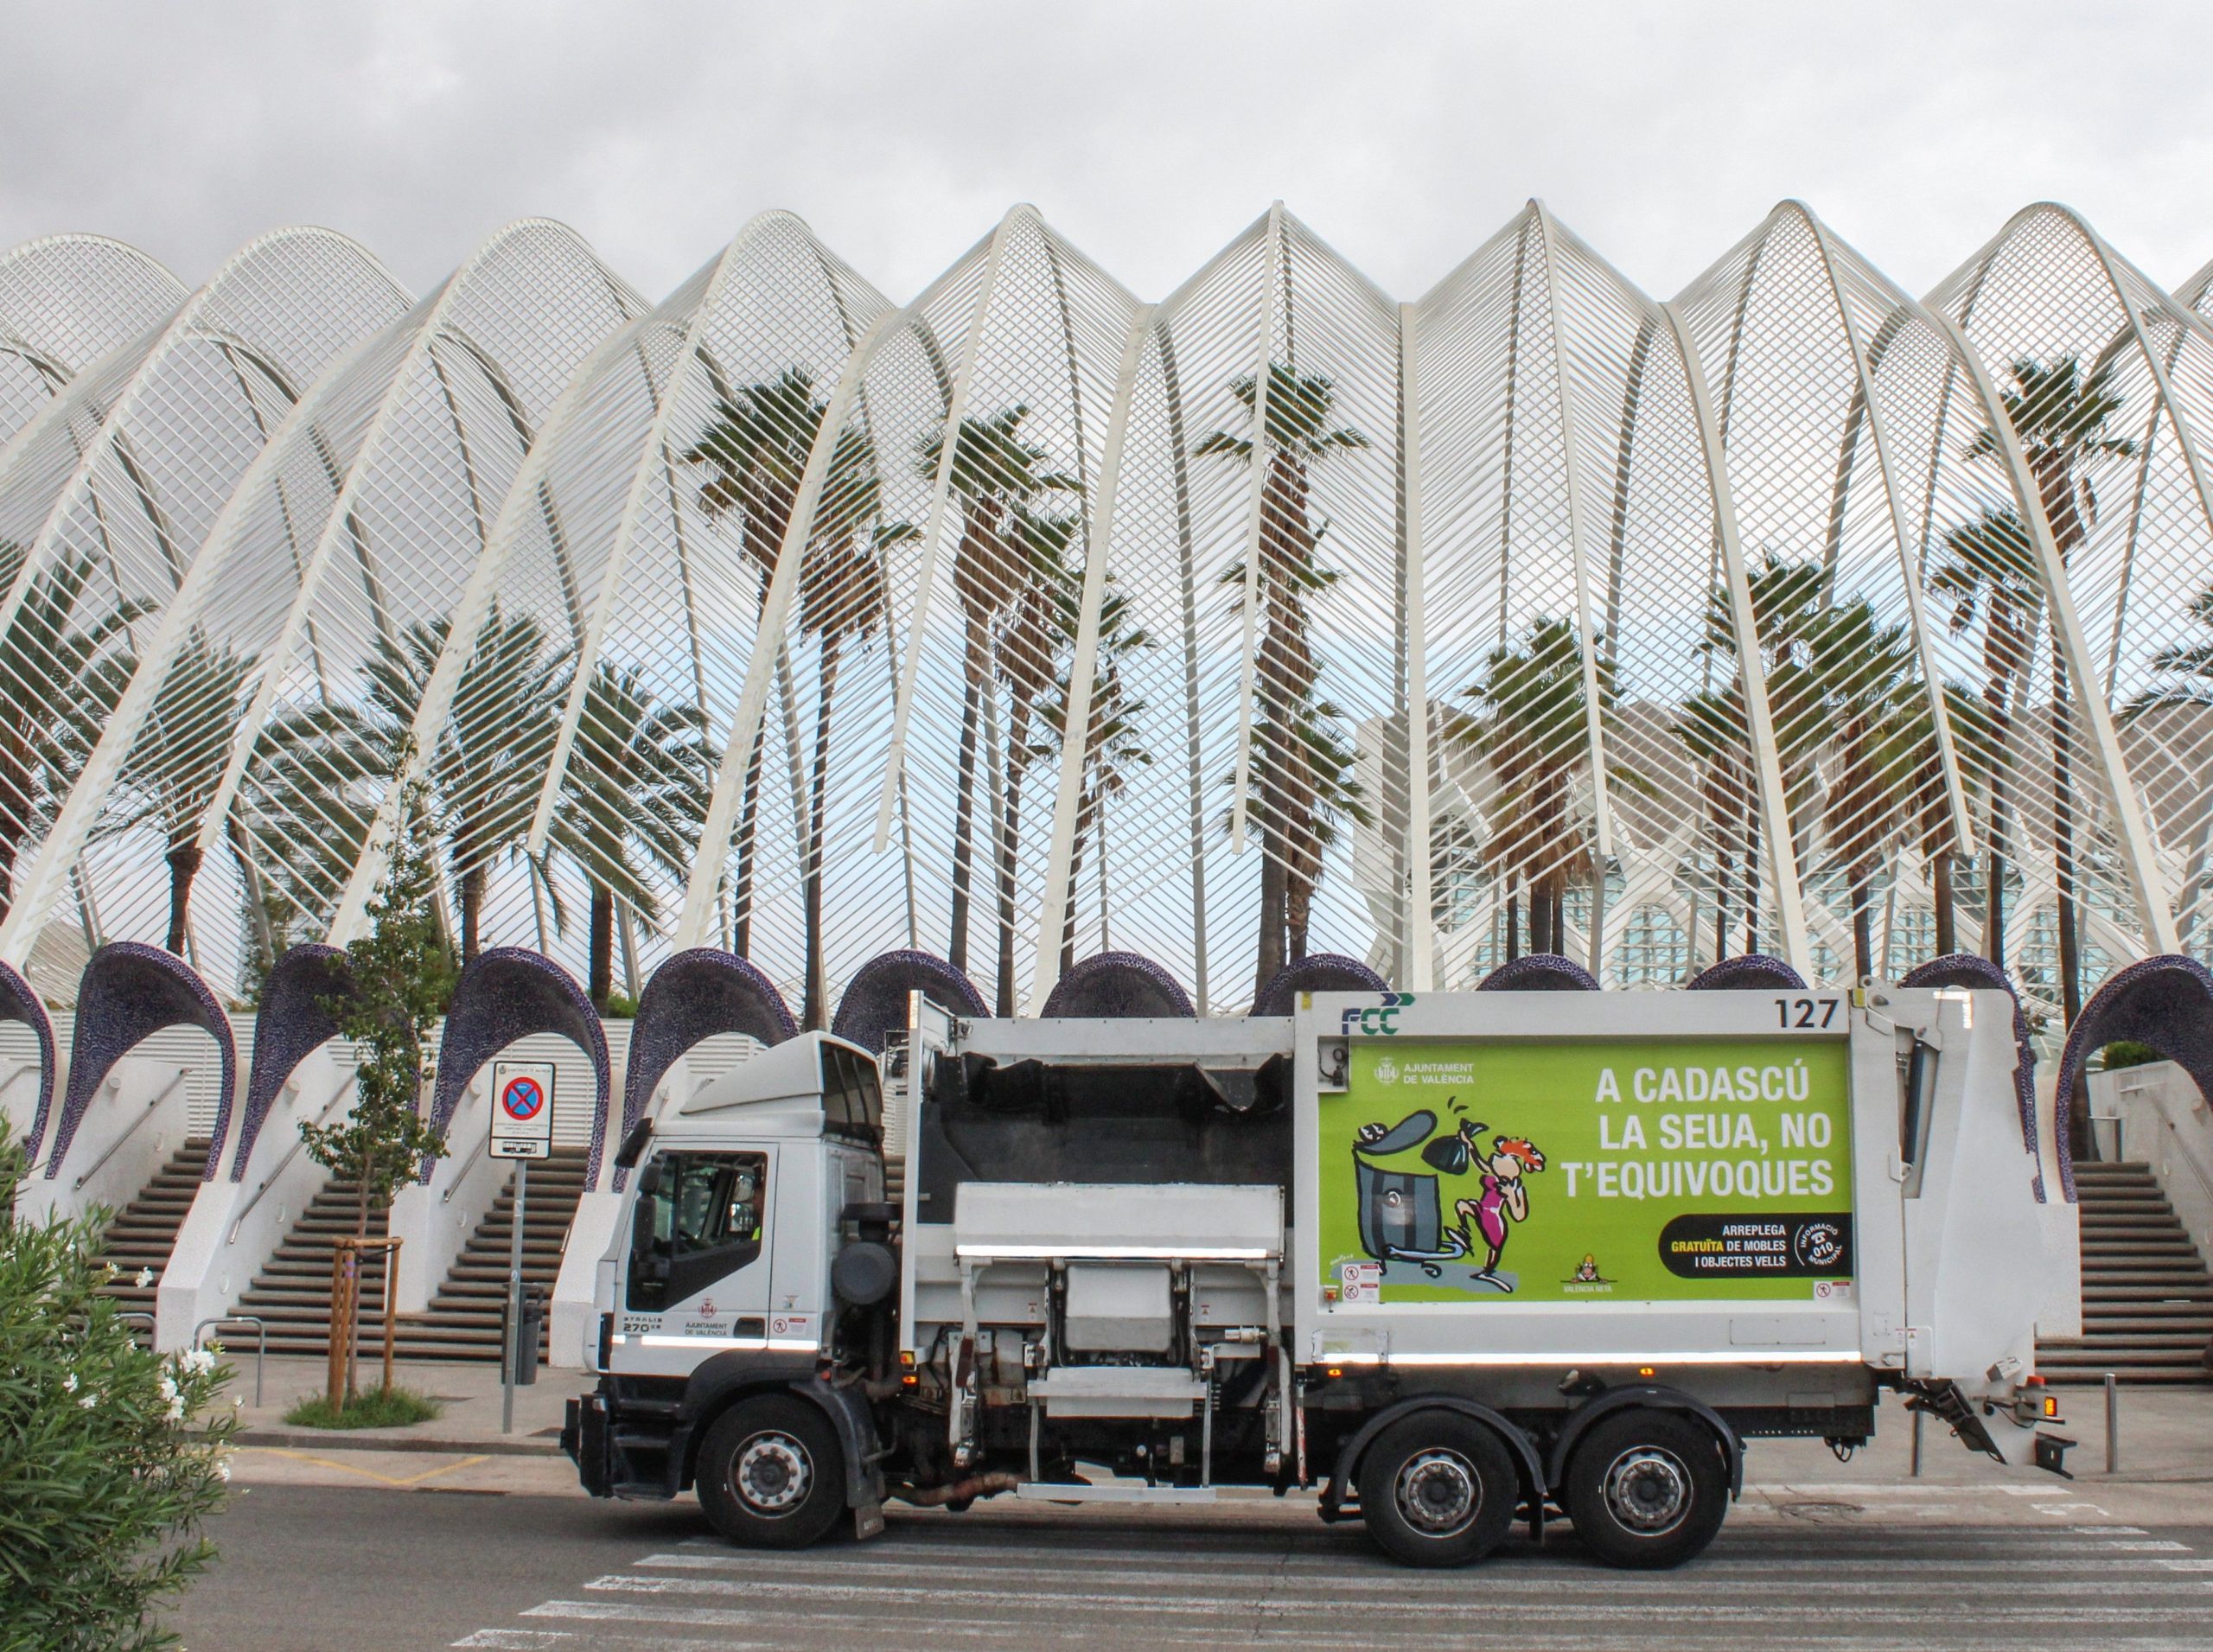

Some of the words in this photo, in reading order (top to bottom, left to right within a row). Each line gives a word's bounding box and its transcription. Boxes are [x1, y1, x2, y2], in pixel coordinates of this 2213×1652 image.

[1342, 1008, 1400, 1036] FCC
[1775, 998, 1839, 1028] 127
[1403, 1062, 1474, 1073] AJUNTAMENT
[1403, 1075, 1418, 1084] DE
[1422, 1073, 1474, 1084] VALÈNCIA
[1595, 1068, 1622, 1103] A
[1633, 1058, 1809, 1104] CADASCÚ
[1599, 1114, 1648, 1150] LA
[1658, 1113, 1769, 1155] SEUA,
[1781, 1112, 1832, 1149] NO
[1559, 1159, 1834, 1200] T’EQUIVOQUES
[1722, 1224, 1787, 1236] ARREPLEGA
[1800, 1222, 1839, 1248] INFORMACIÓ
[1671, 1238, 1724, 1252] GRATUÏTA
[1726, 1241, 1741, 1252] DE
[1744, 1240, 1787, 1252] MOBLES
[1813, 1241, 1834, 1258] 010
[1694, 1257, 1699, 1267] I
[1701, 1256, 1753, 1268] OBJECTES
[1755, 1255, 1787, 1267] VELLS
[1808, 1245, 1842, 1266] MUNICIPAL
[623, 1323, 649, 1332] 270
